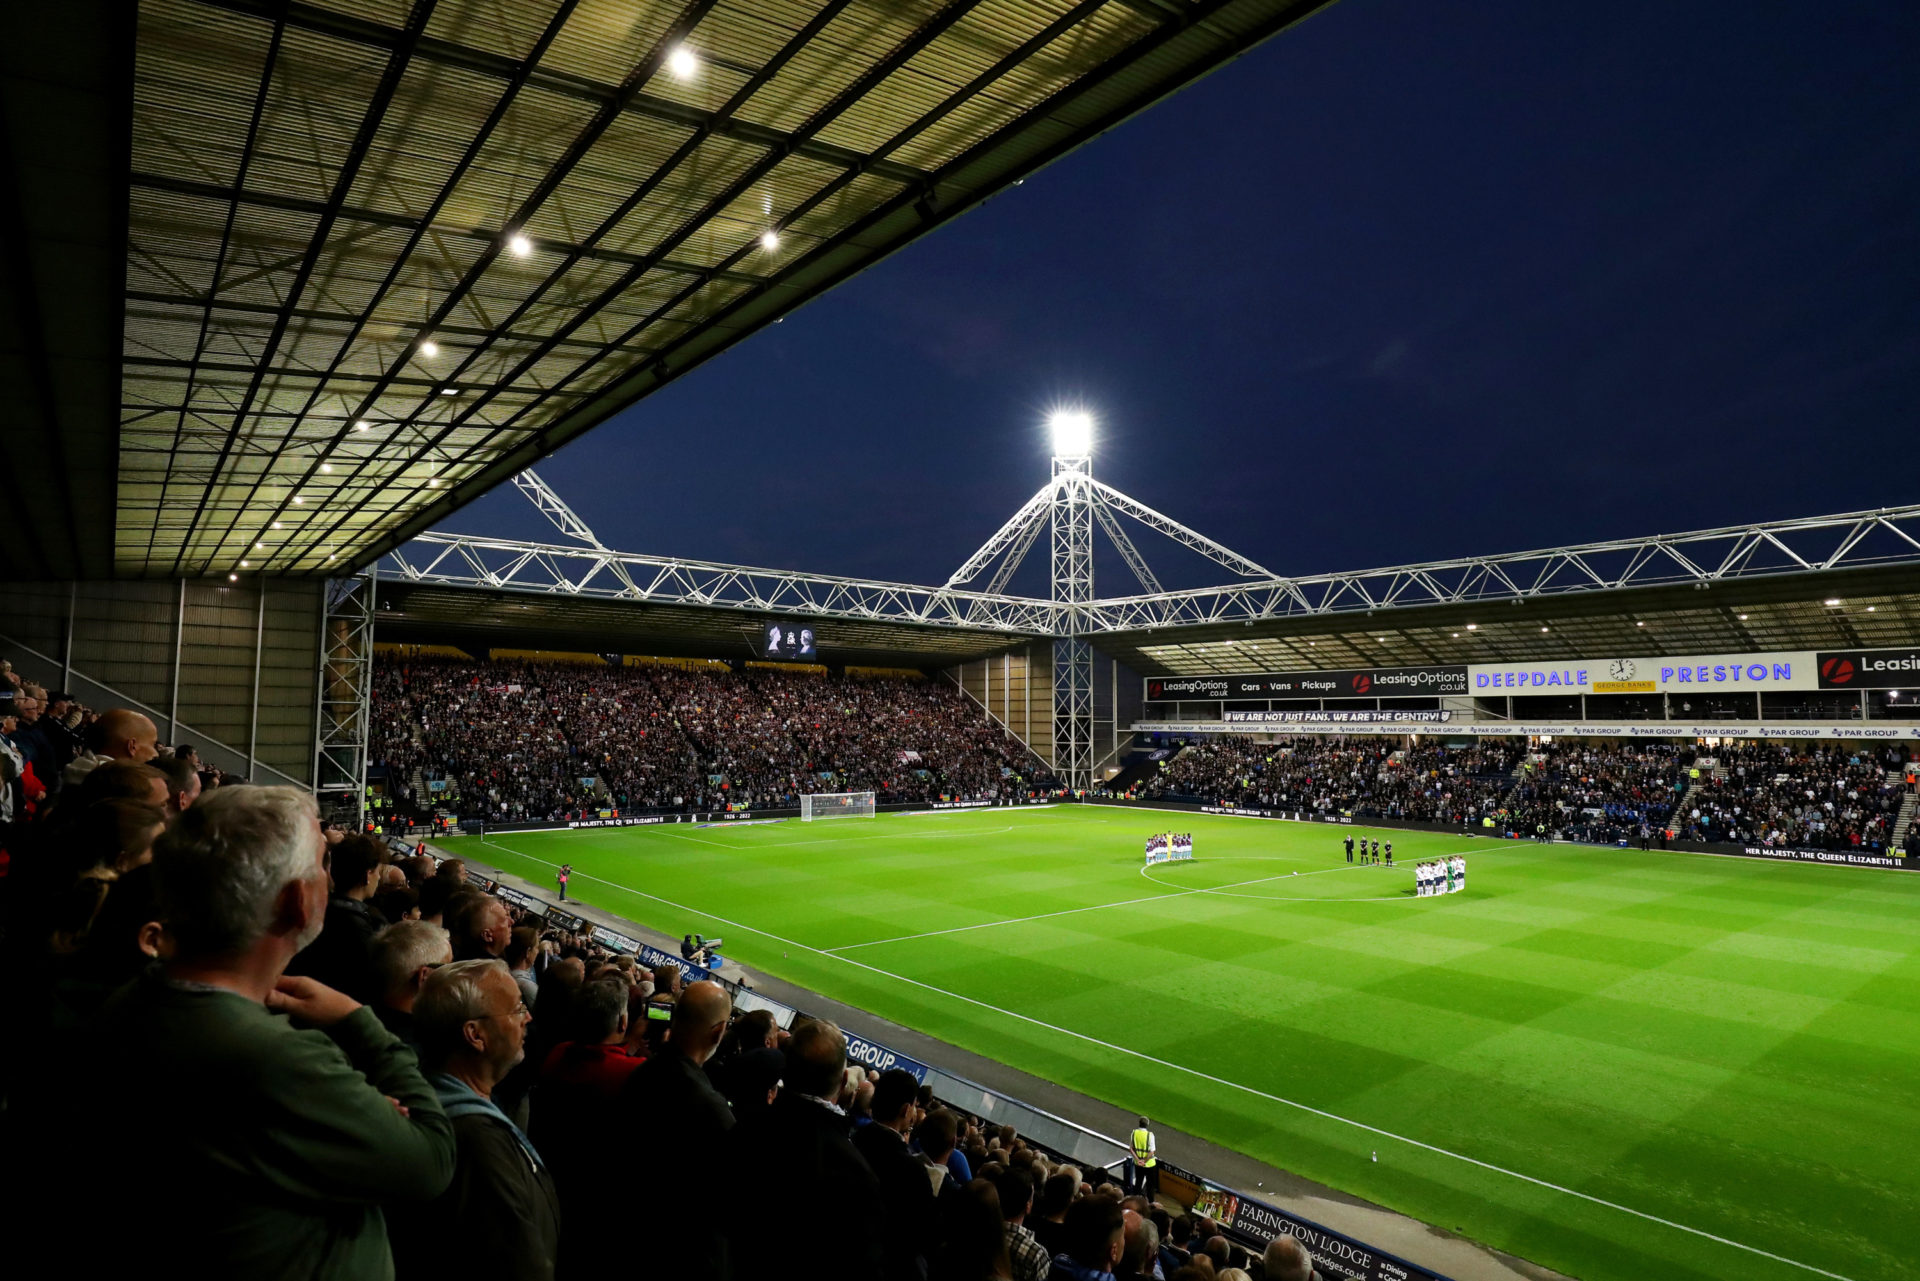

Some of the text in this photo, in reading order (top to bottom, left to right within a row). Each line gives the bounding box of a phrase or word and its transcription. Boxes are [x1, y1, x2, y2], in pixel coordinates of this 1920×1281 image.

[1373, 671, 1466, 687] LeasingOptions
[1476, 663, 1791, 687] DEEPDALE PRESTON
[1164, 680, 1228, 693] LeasingOptions
[1241, 680, 1336, 691] Cars Vans Pickups
[1438, 682, 1466, 691] .co.uk
[1232, 712, 1439, 721] WE ARE NOT JUST FANS. WE ARE THE GENTRY!
[1762, 850, 1798, 858] MAJESTY,
[1817, 852, 1846, 862] QUEEN
[1849, 854, 1892, 866] ELIZABETH
[1237, 1219, 1262, 1236] 01772
[1240, 1203, 1372, 1269] FARINGTON LODGE
[1386, 1263, 1408, 1280] Dining
